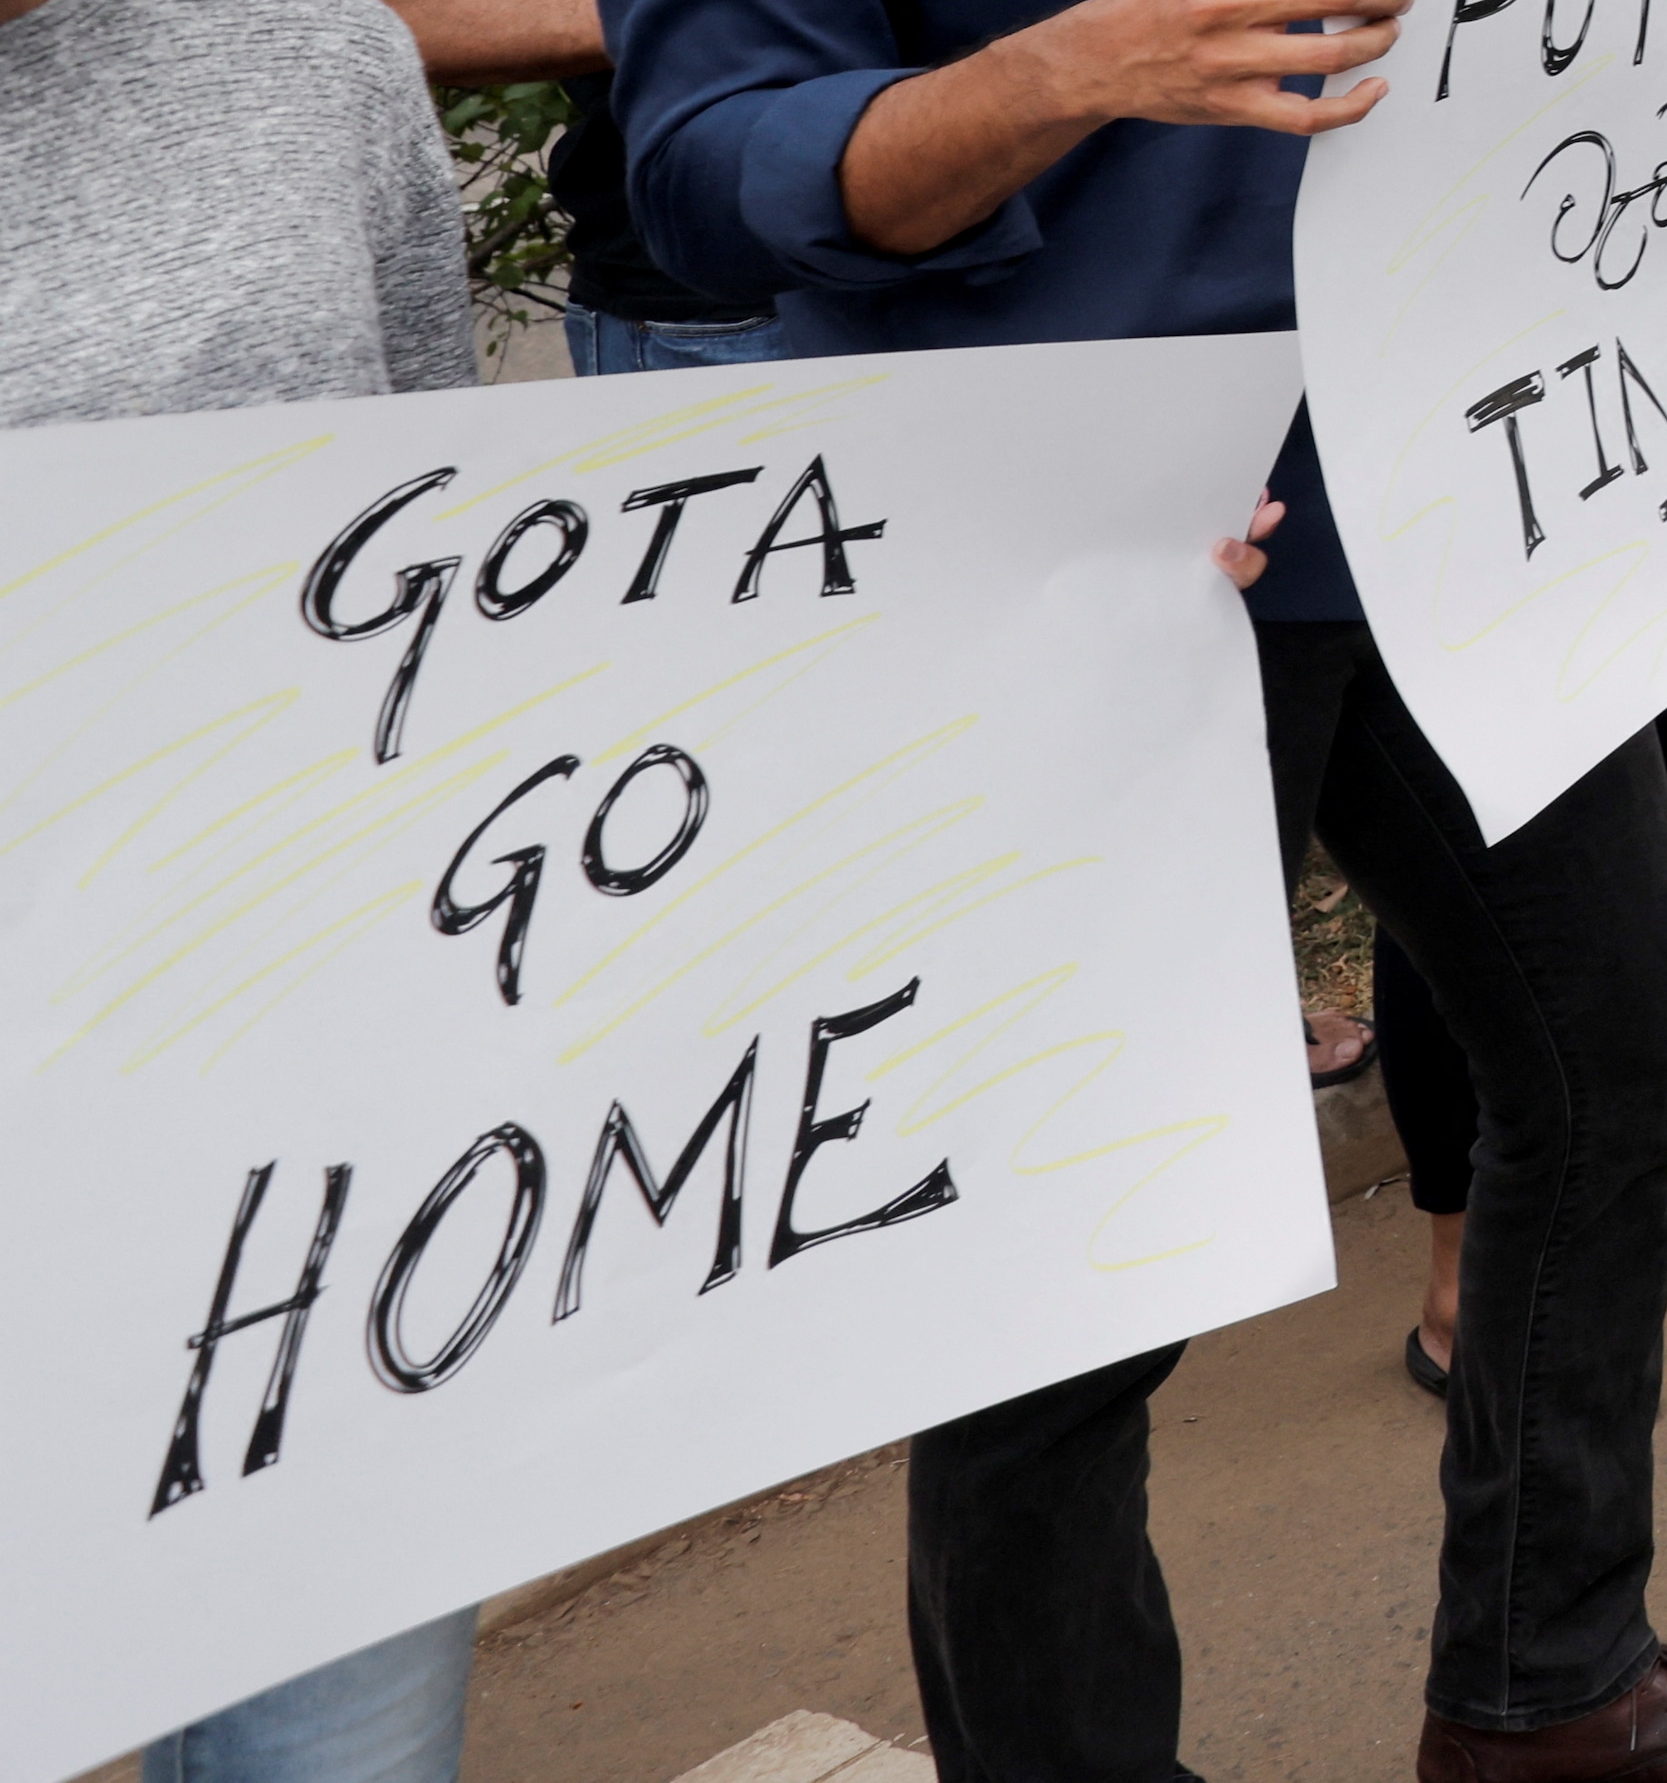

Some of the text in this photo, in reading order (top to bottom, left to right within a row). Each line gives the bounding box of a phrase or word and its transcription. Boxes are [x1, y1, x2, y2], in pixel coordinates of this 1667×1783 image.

[301, 454, 889, 765] GOTA
[430, 743, 711, 1006] GO
[147, 976, 960, 1520] HOME
